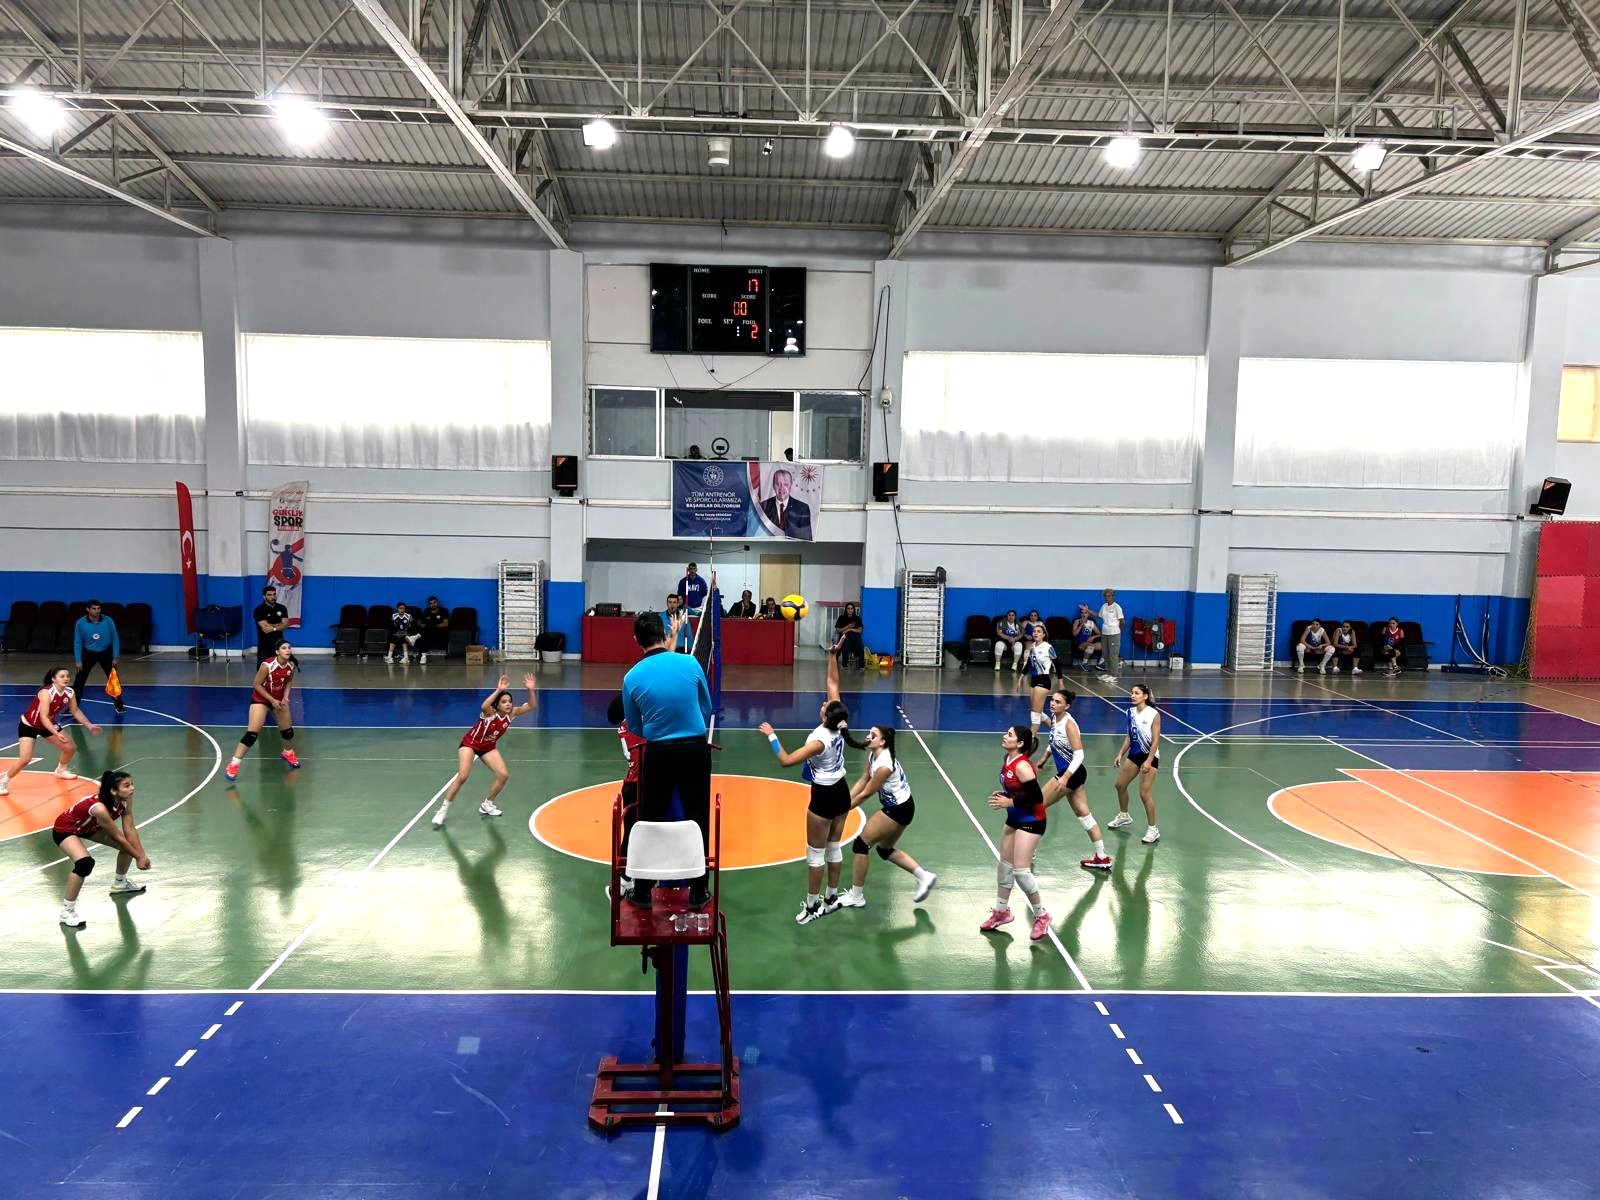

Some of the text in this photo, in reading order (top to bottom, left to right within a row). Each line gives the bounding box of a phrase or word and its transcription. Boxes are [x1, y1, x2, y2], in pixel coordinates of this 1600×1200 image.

[748, 279, 759, 292] 17
[733, 301, 747, 316] 00
[751, 324, 759, 339] 2
[273, 515, 303, 527] SPOR
